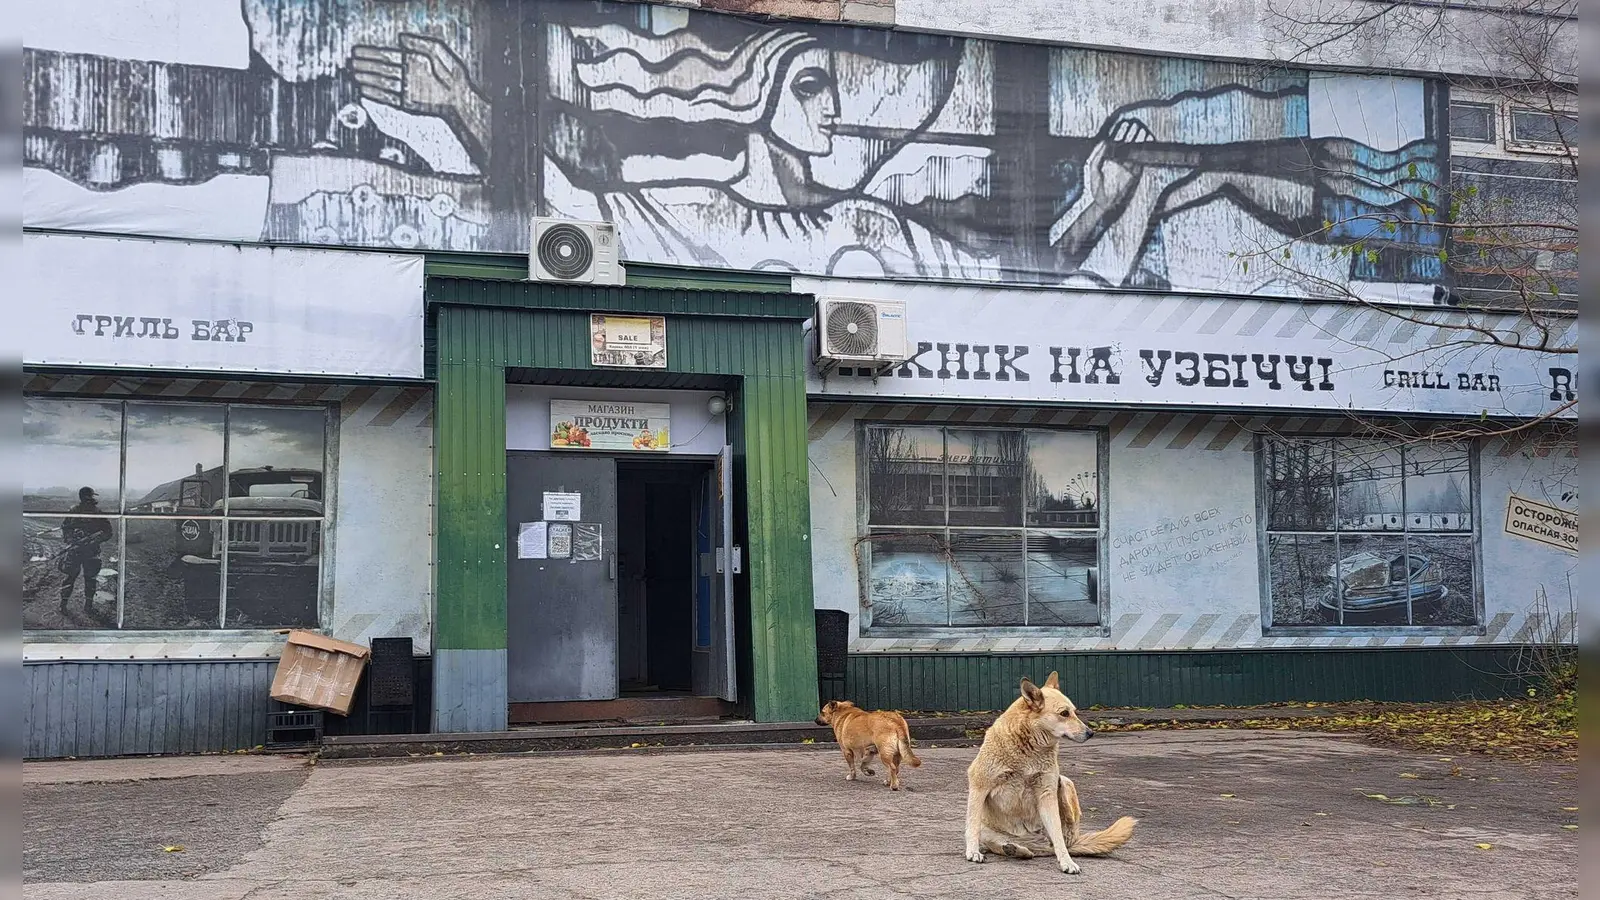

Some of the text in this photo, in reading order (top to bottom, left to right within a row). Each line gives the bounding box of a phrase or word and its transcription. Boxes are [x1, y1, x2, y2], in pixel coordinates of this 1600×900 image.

[75, 314, 254, 343] ГРИЛЬ БАР
[618, 334, 638, 342] SALE
[838, 341, 1335, 391] КНІК НА УЗБІЧЧІ
[1384, 369, 1501, 391] GRILL BAR
[1549, 367, 1578, 401] R
[588, 404, 635, 415] МАГАЗИН
[574, 416, 649, 430] ПРОДУКТИ
[1112, 506, 1221, 549] СЧАСТЬЕ ДЛЯ ВСЕХ
[1175, 529, 1214, 548] ПУСТЬ
[1217, 513, 1253, 534] НИКТО
[1512, 520, 1560, 540] ОПАСНАЯ
[1122, 570, 1137, 583] НЕ
